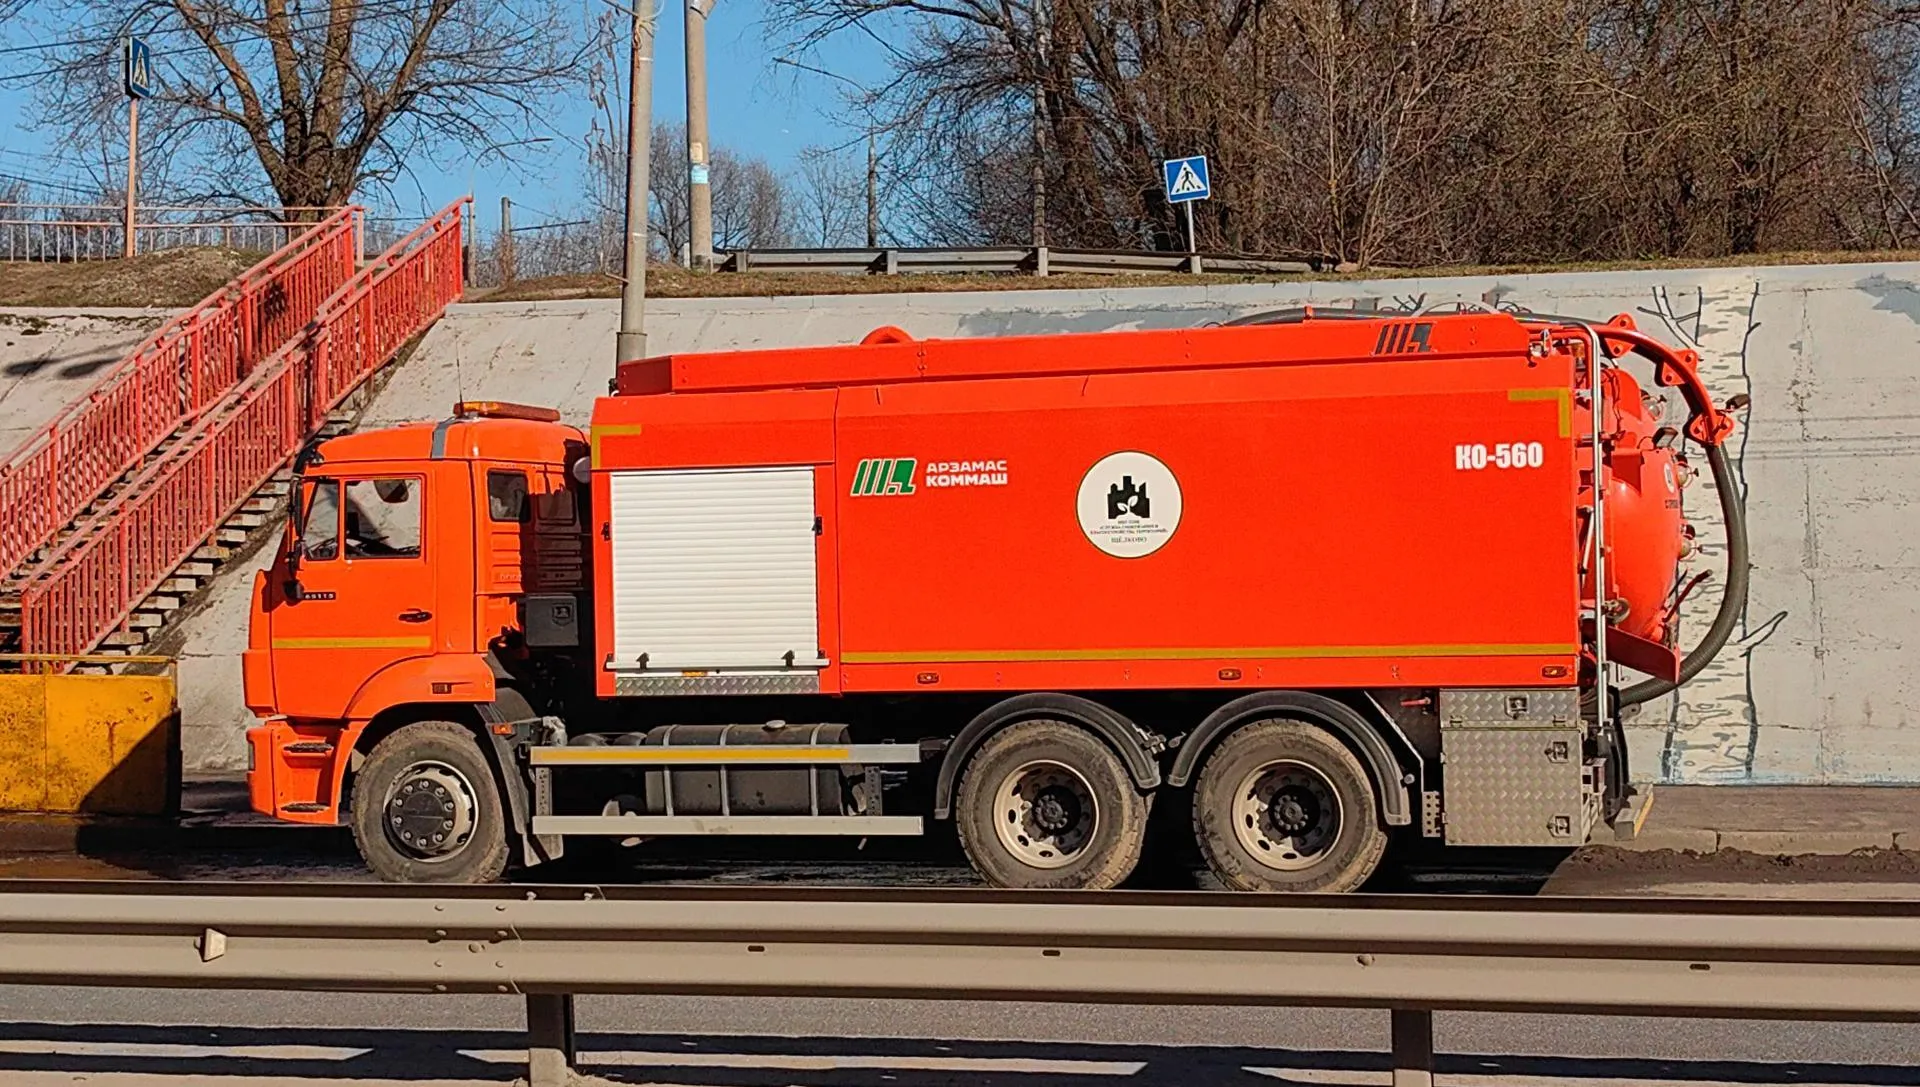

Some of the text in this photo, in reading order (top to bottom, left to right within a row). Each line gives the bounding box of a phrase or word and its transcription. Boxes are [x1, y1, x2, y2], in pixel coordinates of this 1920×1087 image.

[1455, 441, 1543, 470] КО-560
[925, 459, 1008, 474] АРЗАМАС
[925, 472, 1008, 488] КОММАШ
